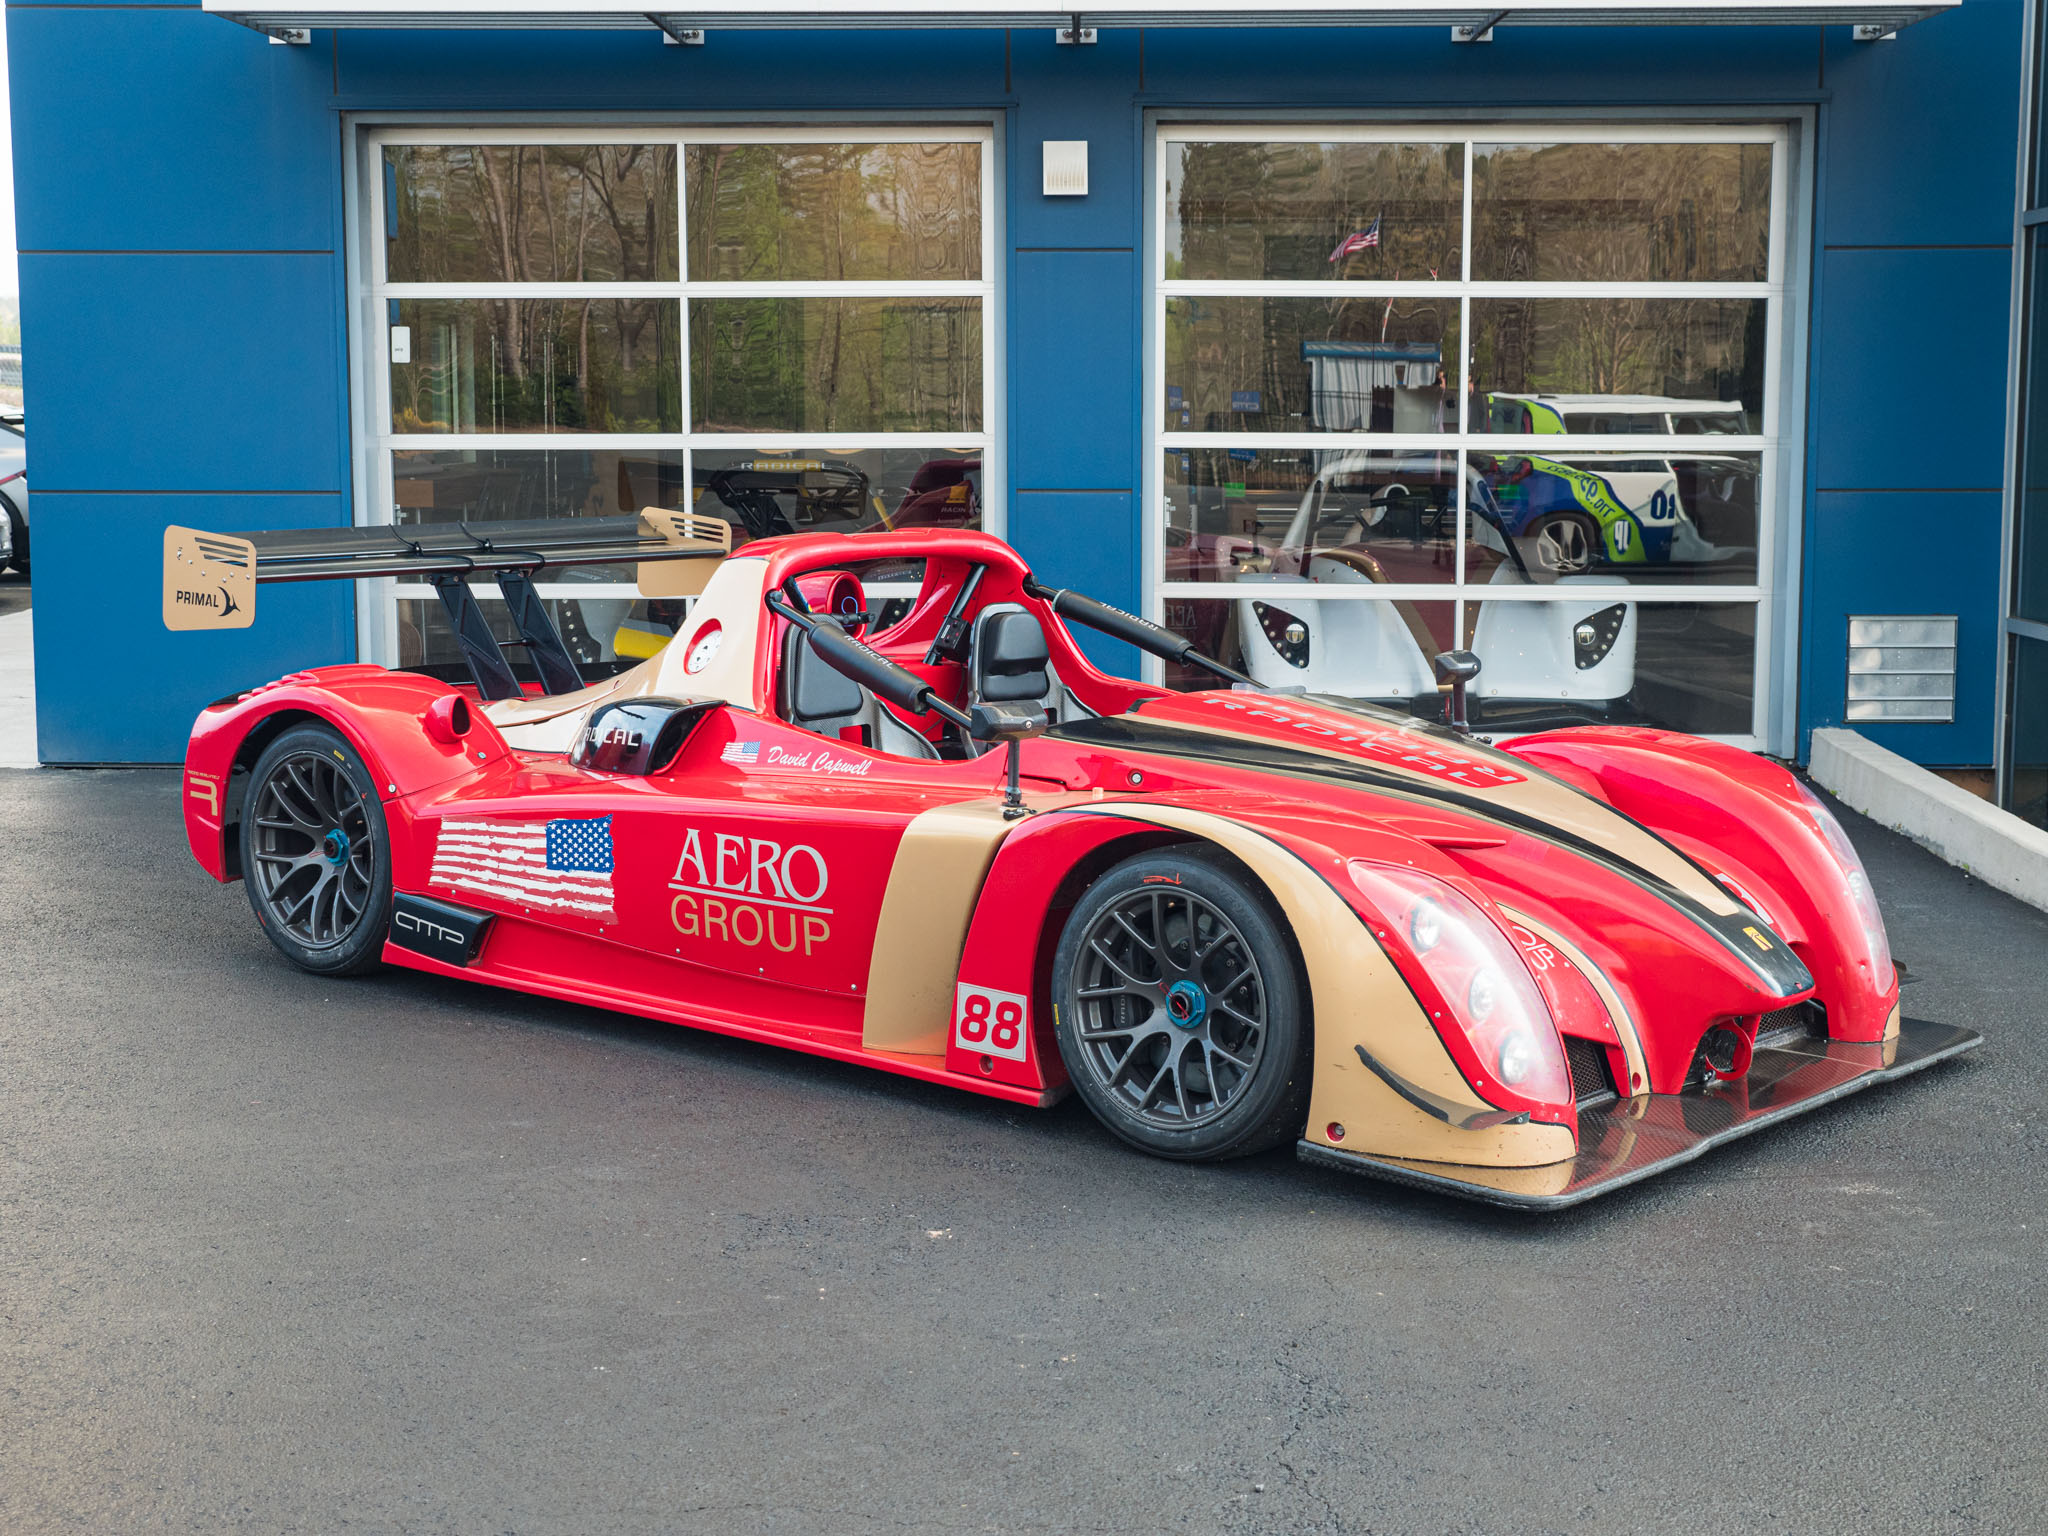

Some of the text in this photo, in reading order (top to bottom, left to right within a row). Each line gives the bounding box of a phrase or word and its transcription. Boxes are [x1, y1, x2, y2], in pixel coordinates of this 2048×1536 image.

[740, 462, 833, 470] RADICAL
[176, 590, 219, 608] PRIMAL
[1100, 601, 1159, 631] RADICAL
[844, 634, 894, 670] RADICAL
[577, 725, 640, 747] ADICAL
[1203, 698, 1481, 787] RADICAL
[768, 746, 873, 776] David Capwell
[672, 827, 829, 903] AERO
[671, 894, 830, 956] GROUP
[960, 994, 1023, 1050] 88
